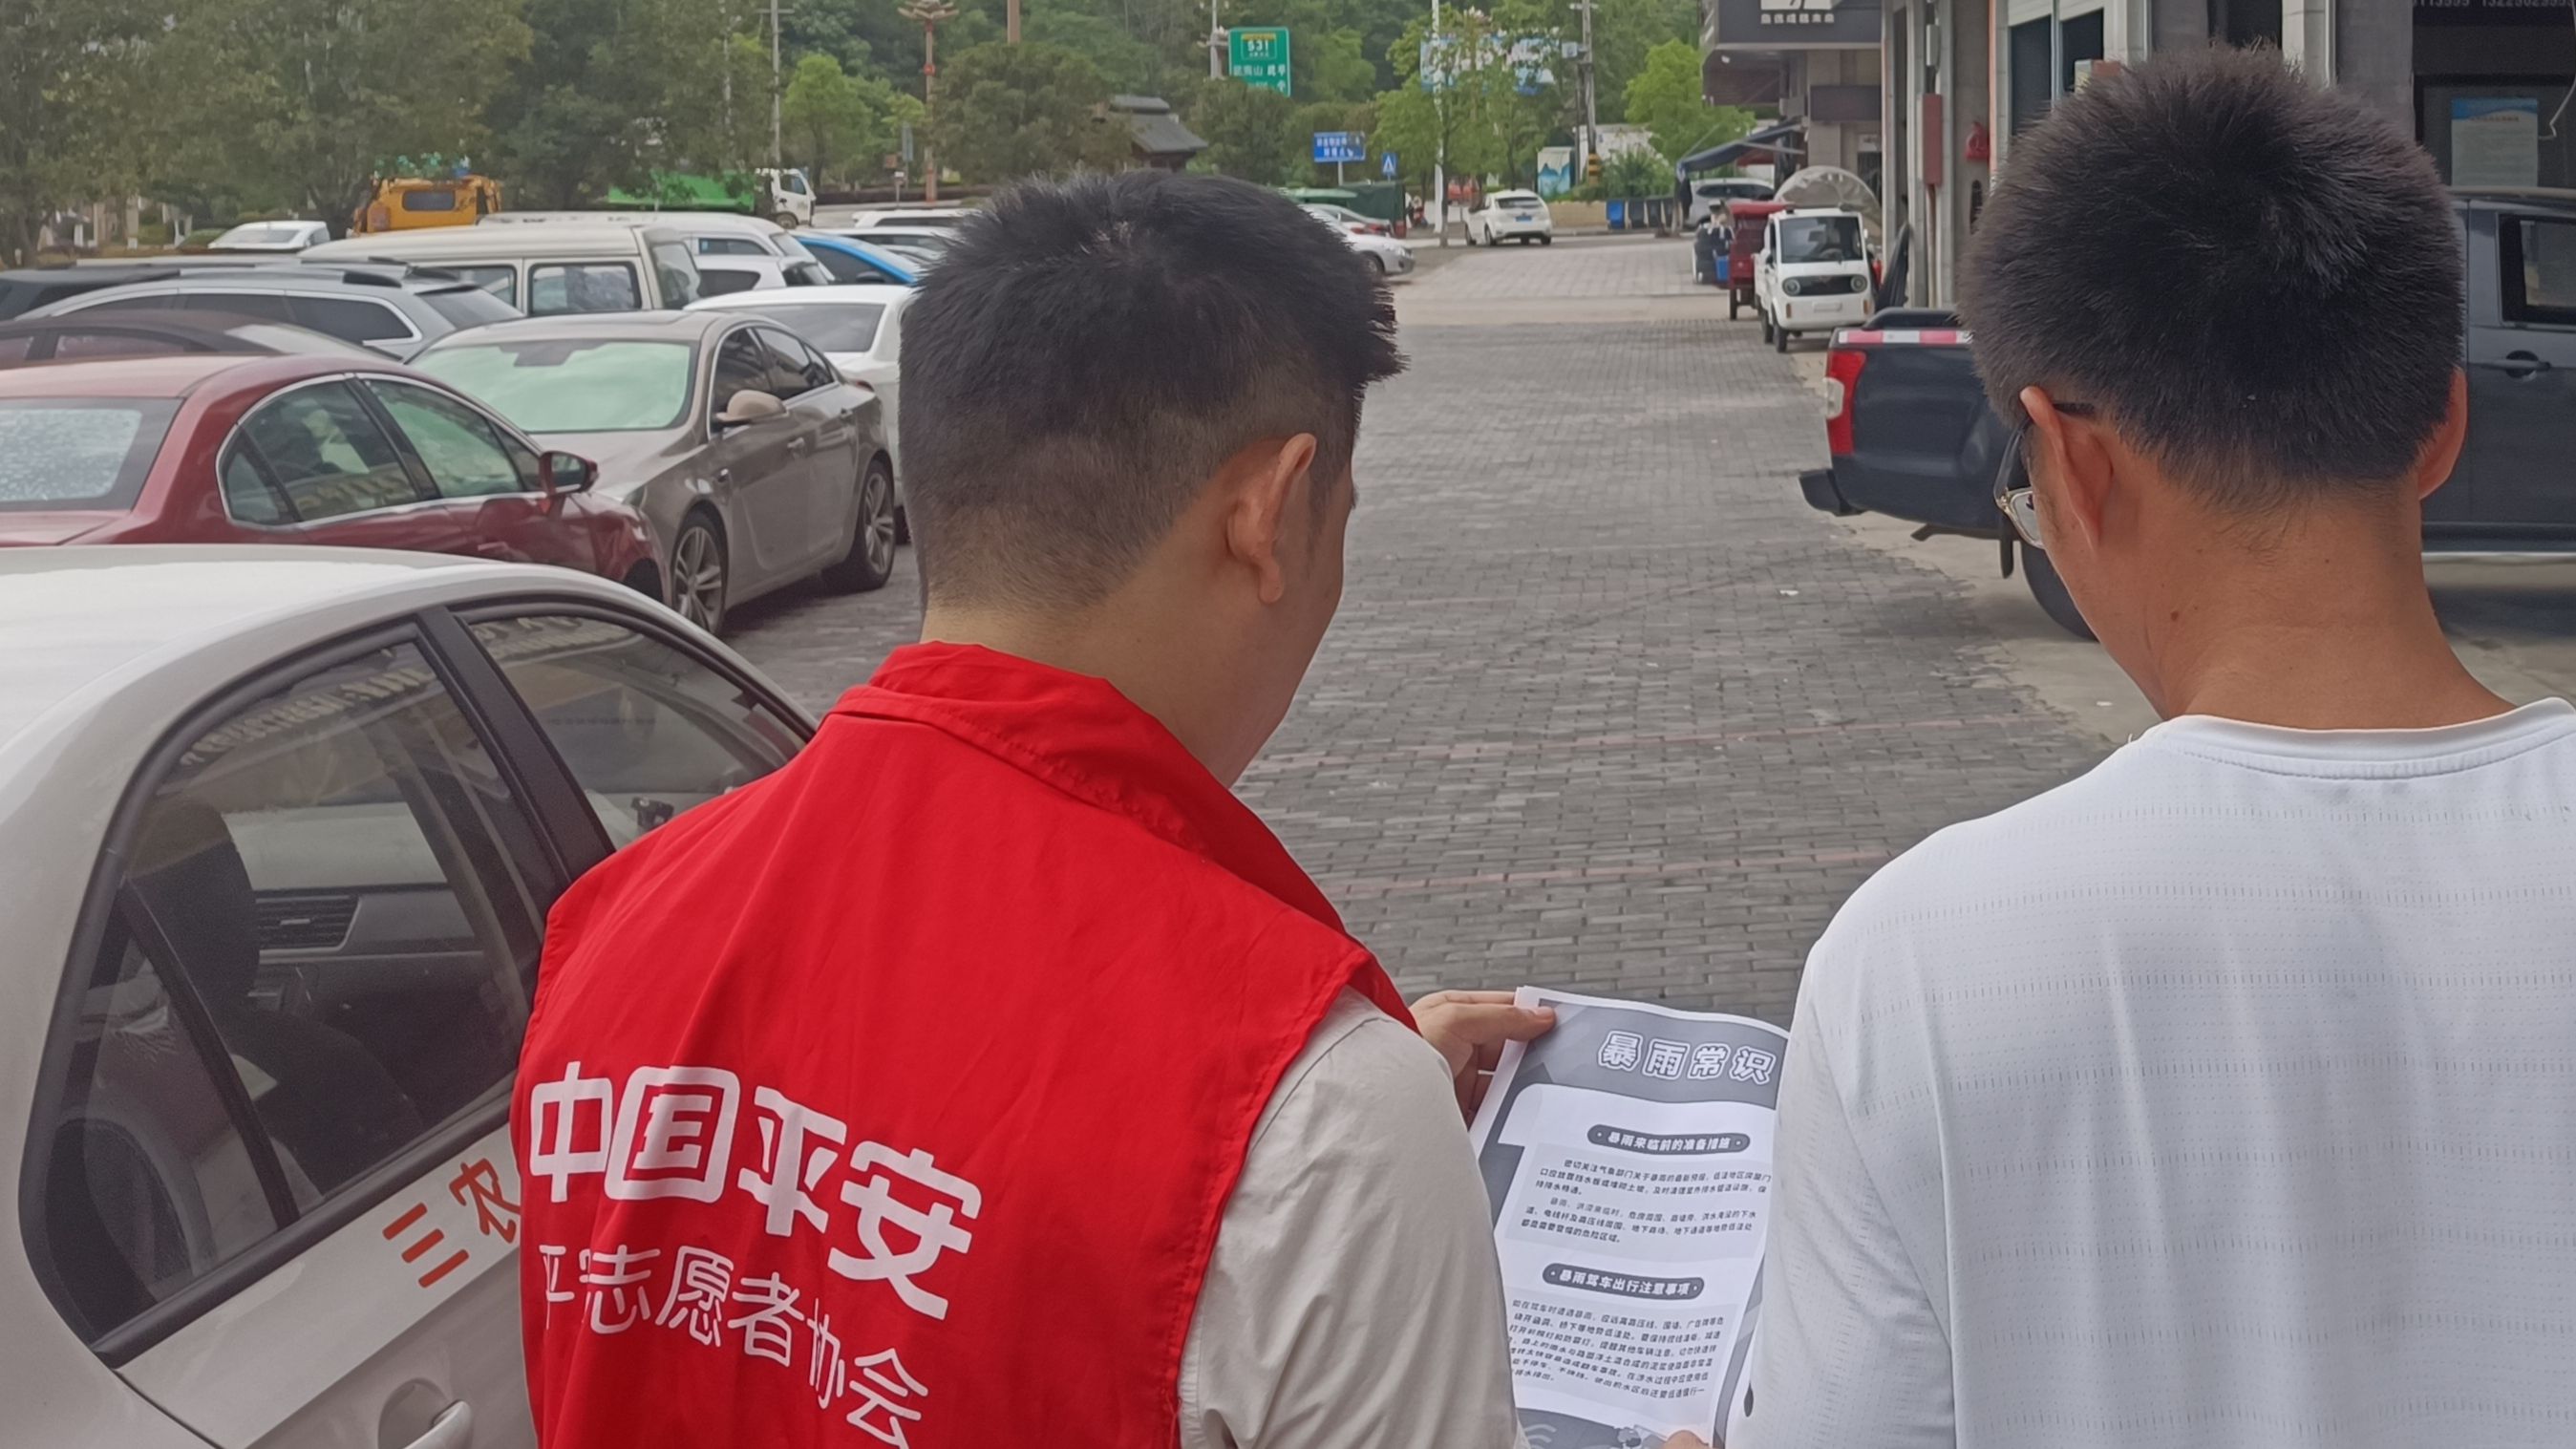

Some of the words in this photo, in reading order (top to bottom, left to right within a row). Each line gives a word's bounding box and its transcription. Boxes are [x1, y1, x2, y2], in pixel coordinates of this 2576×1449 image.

[1598, 1031, 1776, 1085] 暴雨常识
[1608, 1131, 1733, 1151] 暴雨来临前的准备措施
[530, 1060, 982, 1320] 中国平安
[382, 1158, 521, 1288] 三农
[1558, 1268, 1691, 1296] 暴雨驾车出行注意事项
